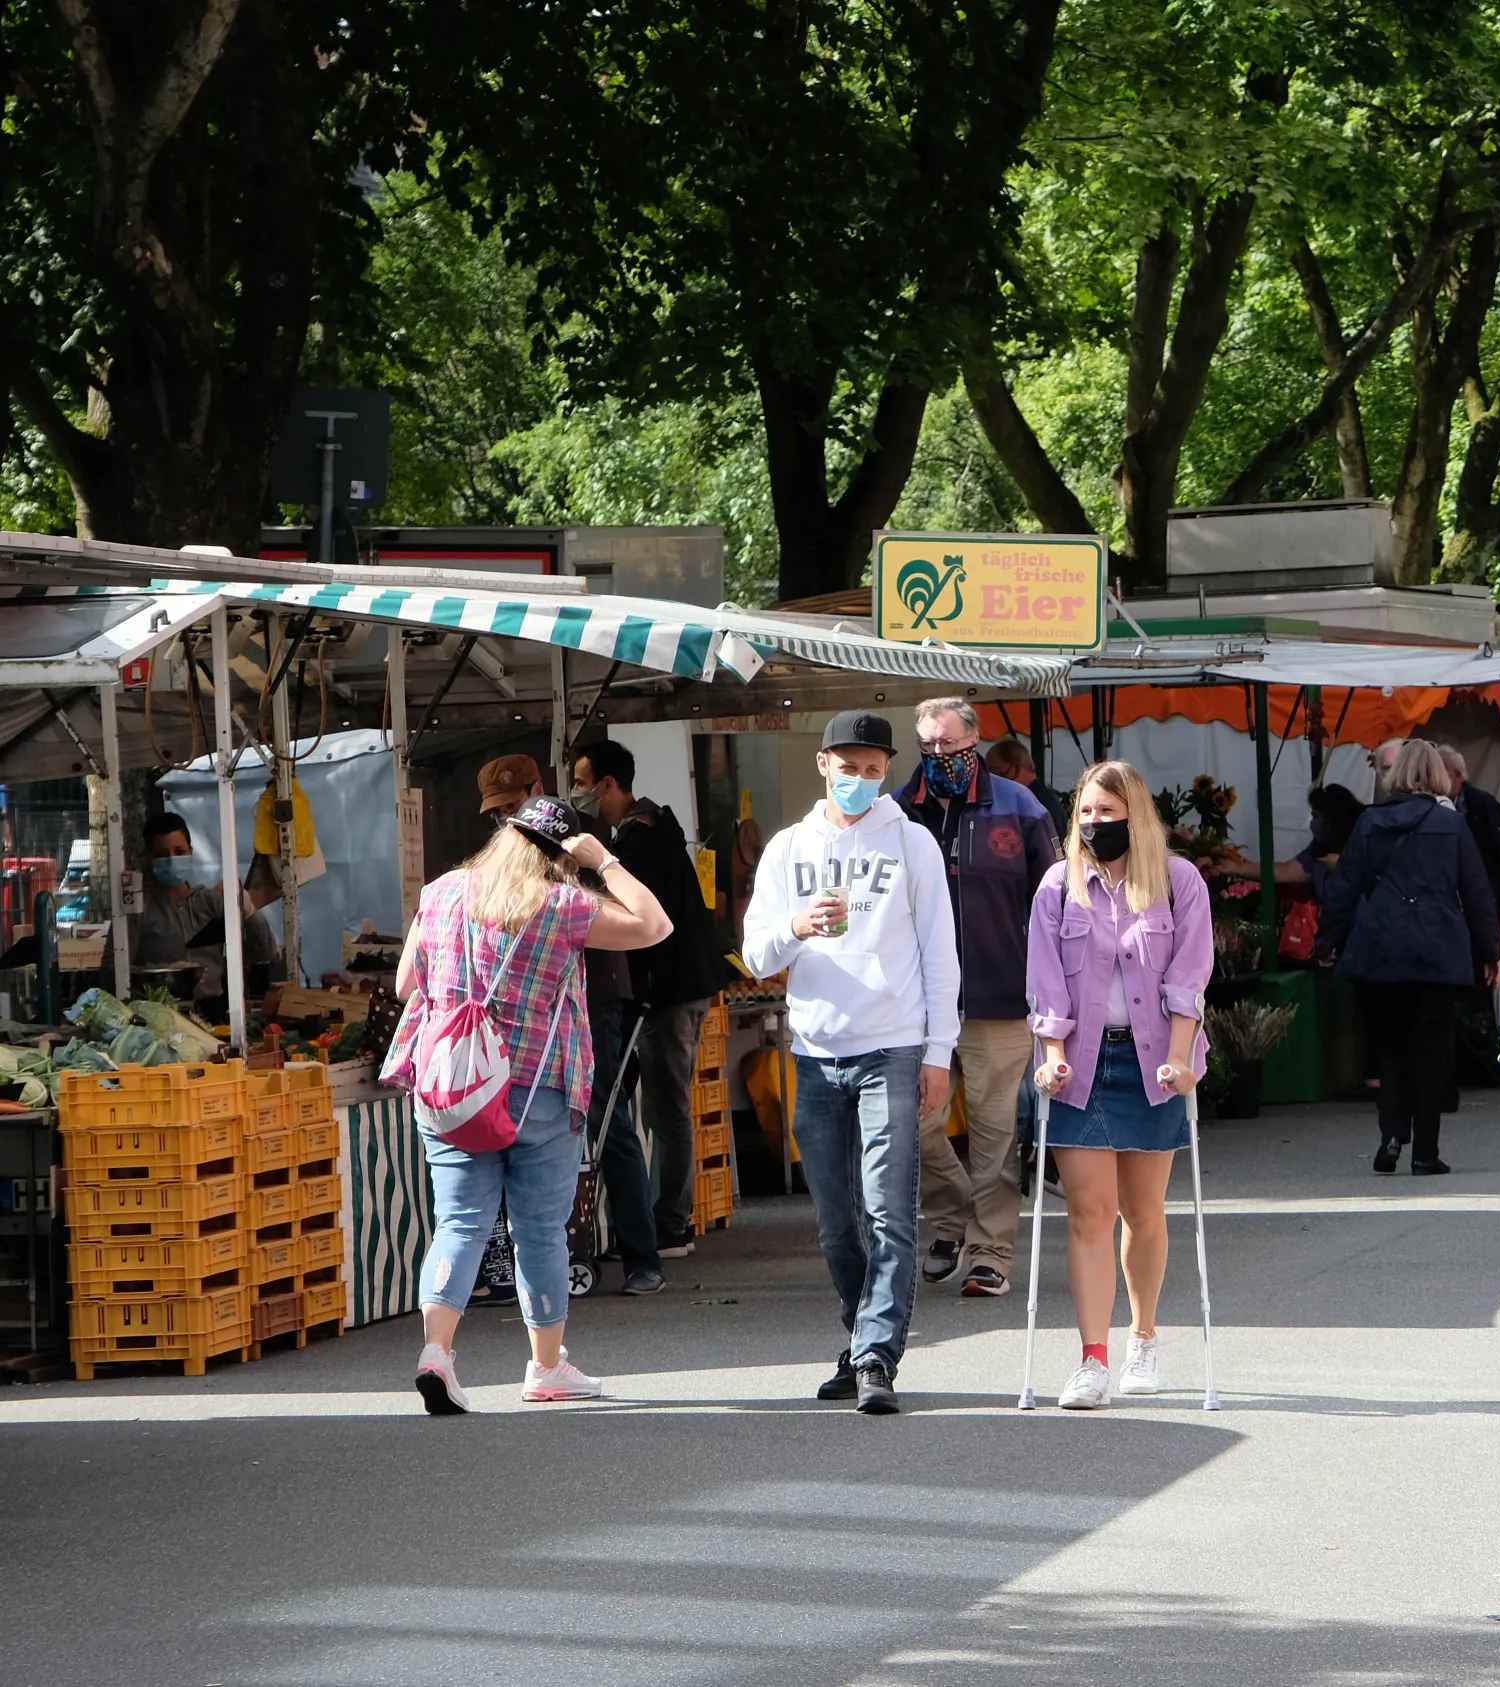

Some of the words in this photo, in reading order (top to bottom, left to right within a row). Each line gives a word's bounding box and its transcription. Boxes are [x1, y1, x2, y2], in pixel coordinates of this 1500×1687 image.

[980, 551, 1052, 568] täglich
[1015, 567, 1086, 583] frische
[980, 585, 1085, 621] Eier
[952, 627, 974, 636] aus
[535, 799, 565, 819] CUTE
[795, 858, 898, 897] DOPE
